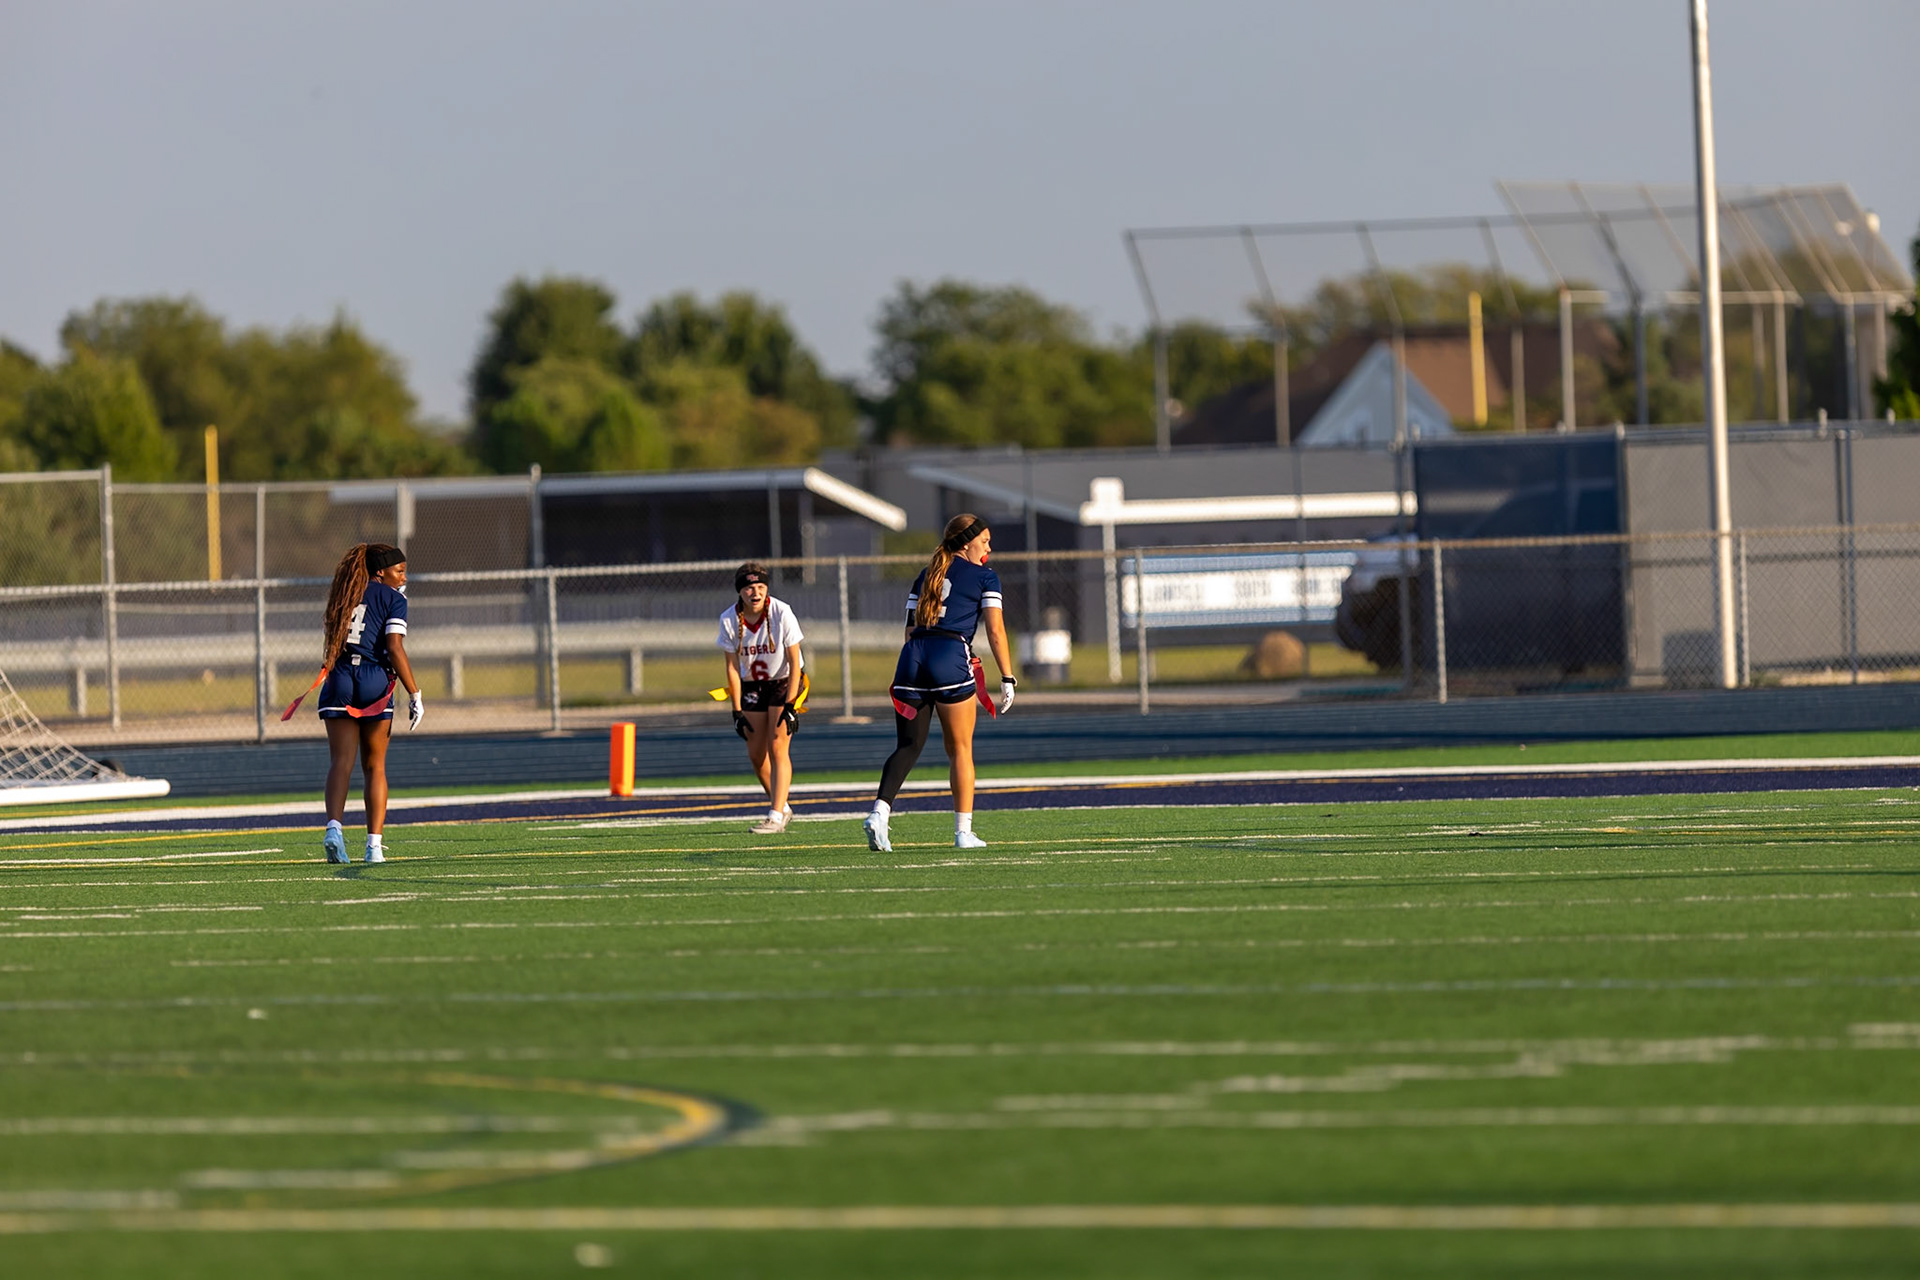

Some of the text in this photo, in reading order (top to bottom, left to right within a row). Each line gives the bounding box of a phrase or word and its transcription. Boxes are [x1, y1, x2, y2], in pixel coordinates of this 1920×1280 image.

[346, 603, 368, 645] 4
[740, 644, 776, 656] IGER
[751, 660, 770, 681] 6
